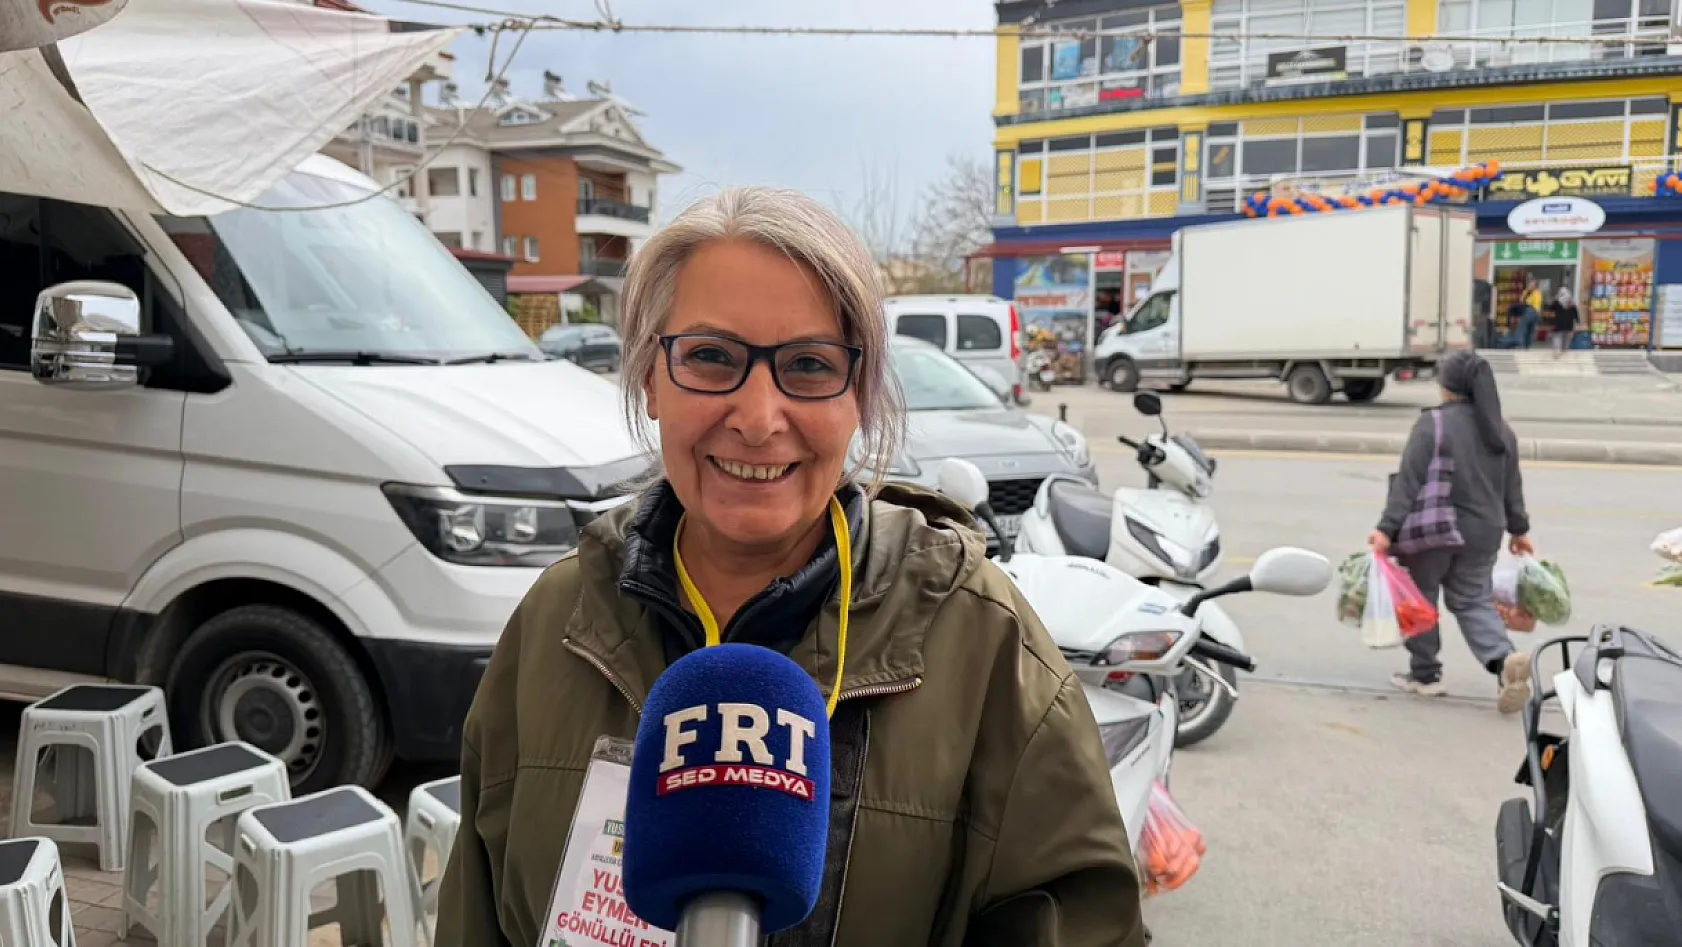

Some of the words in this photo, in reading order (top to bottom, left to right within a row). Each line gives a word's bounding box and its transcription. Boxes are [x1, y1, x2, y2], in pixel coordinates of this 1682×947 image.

[659, 702, 816, 777] FRT
[666, 768, 717, 791] SED
[724, 768, 809, 798] MEDYA
[606, 821, 625, 836] YUS
